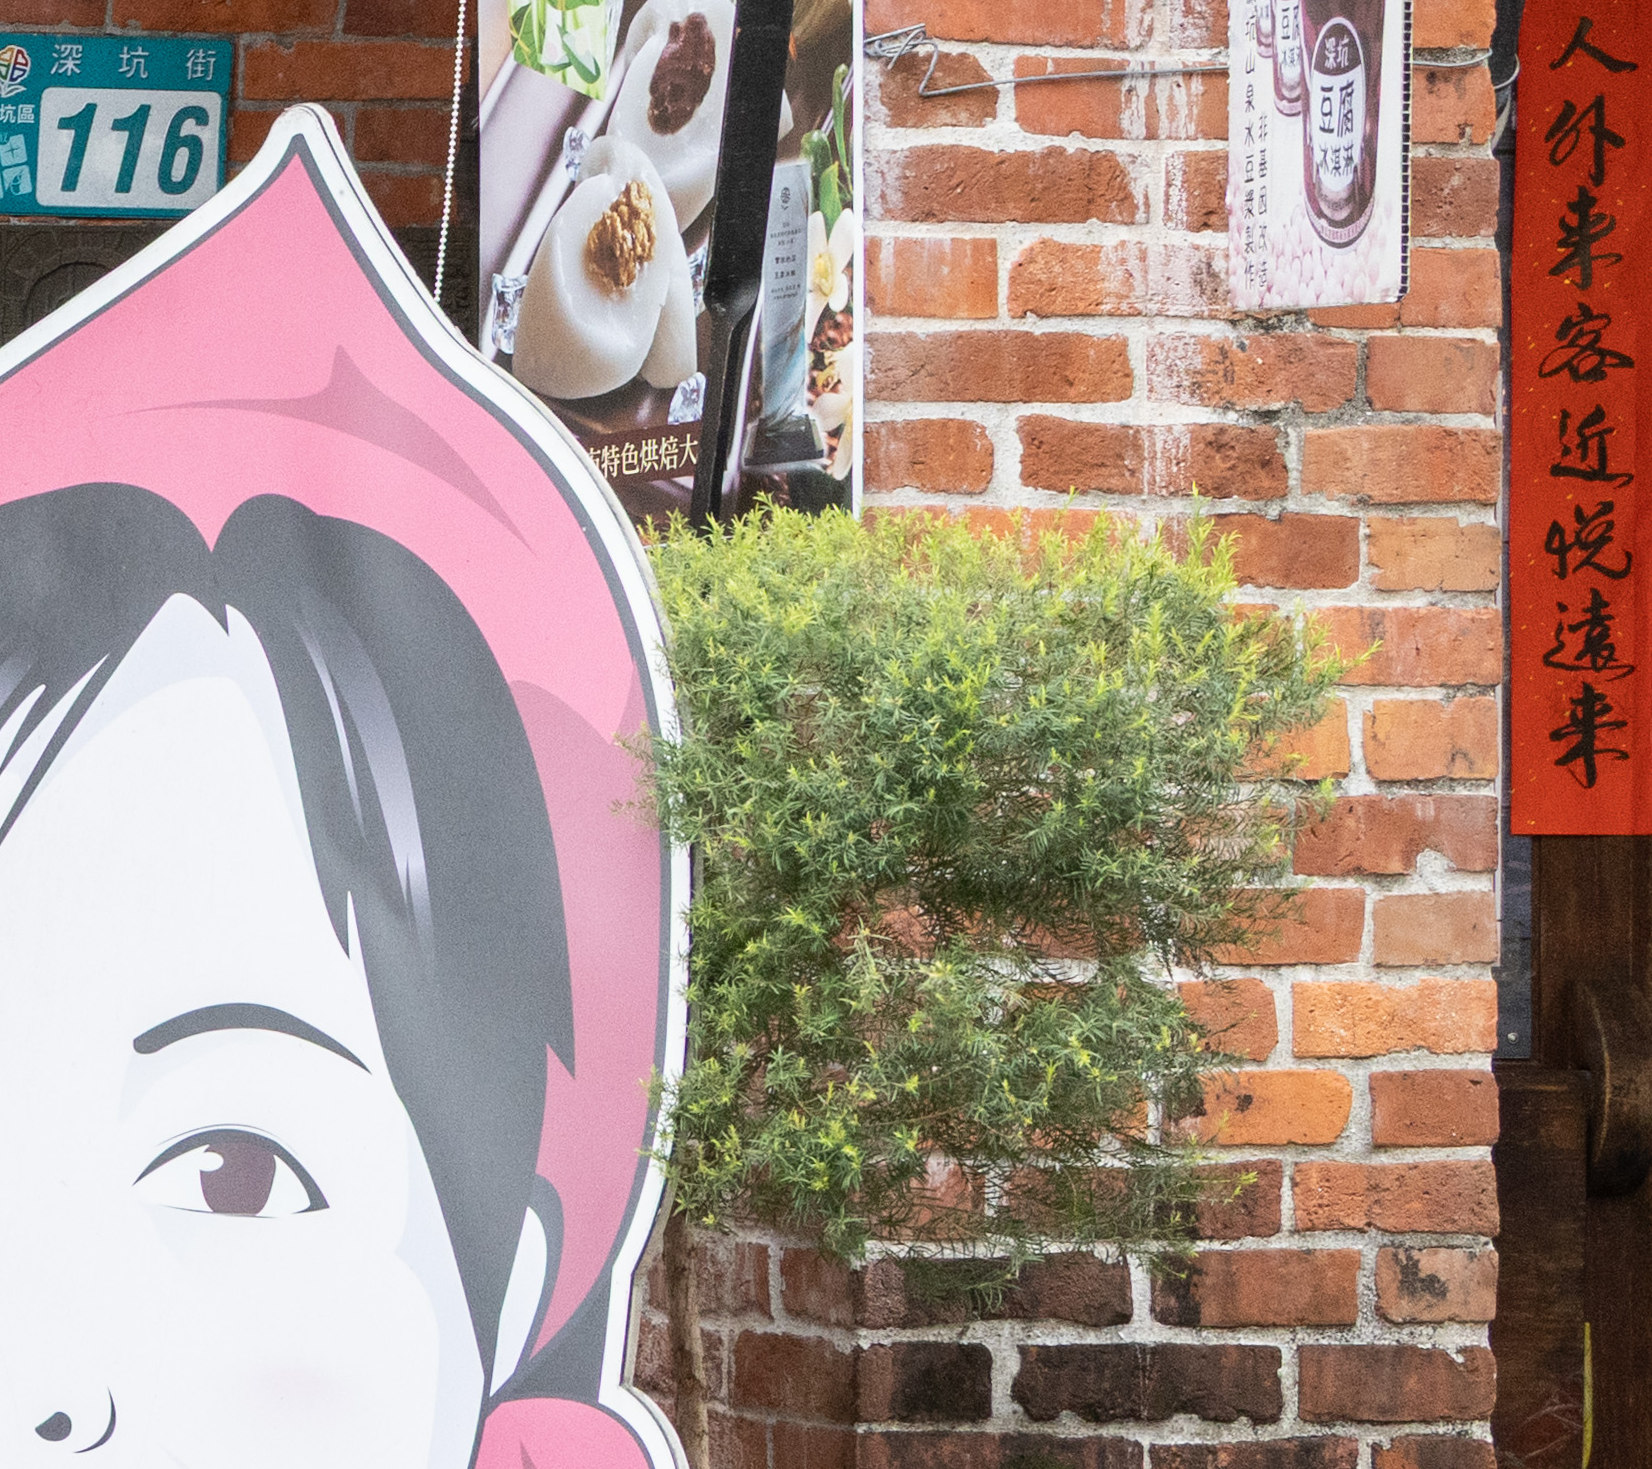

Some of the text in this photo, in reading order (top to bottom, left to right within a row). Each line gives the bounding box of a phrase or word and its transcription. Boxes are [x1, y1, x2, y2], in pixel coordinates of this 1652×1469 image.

[51, 43, 216, 80] 深坑街
[1319, 82, 1360, 139] 豆腐
[57, 102, 210, 196] 116
